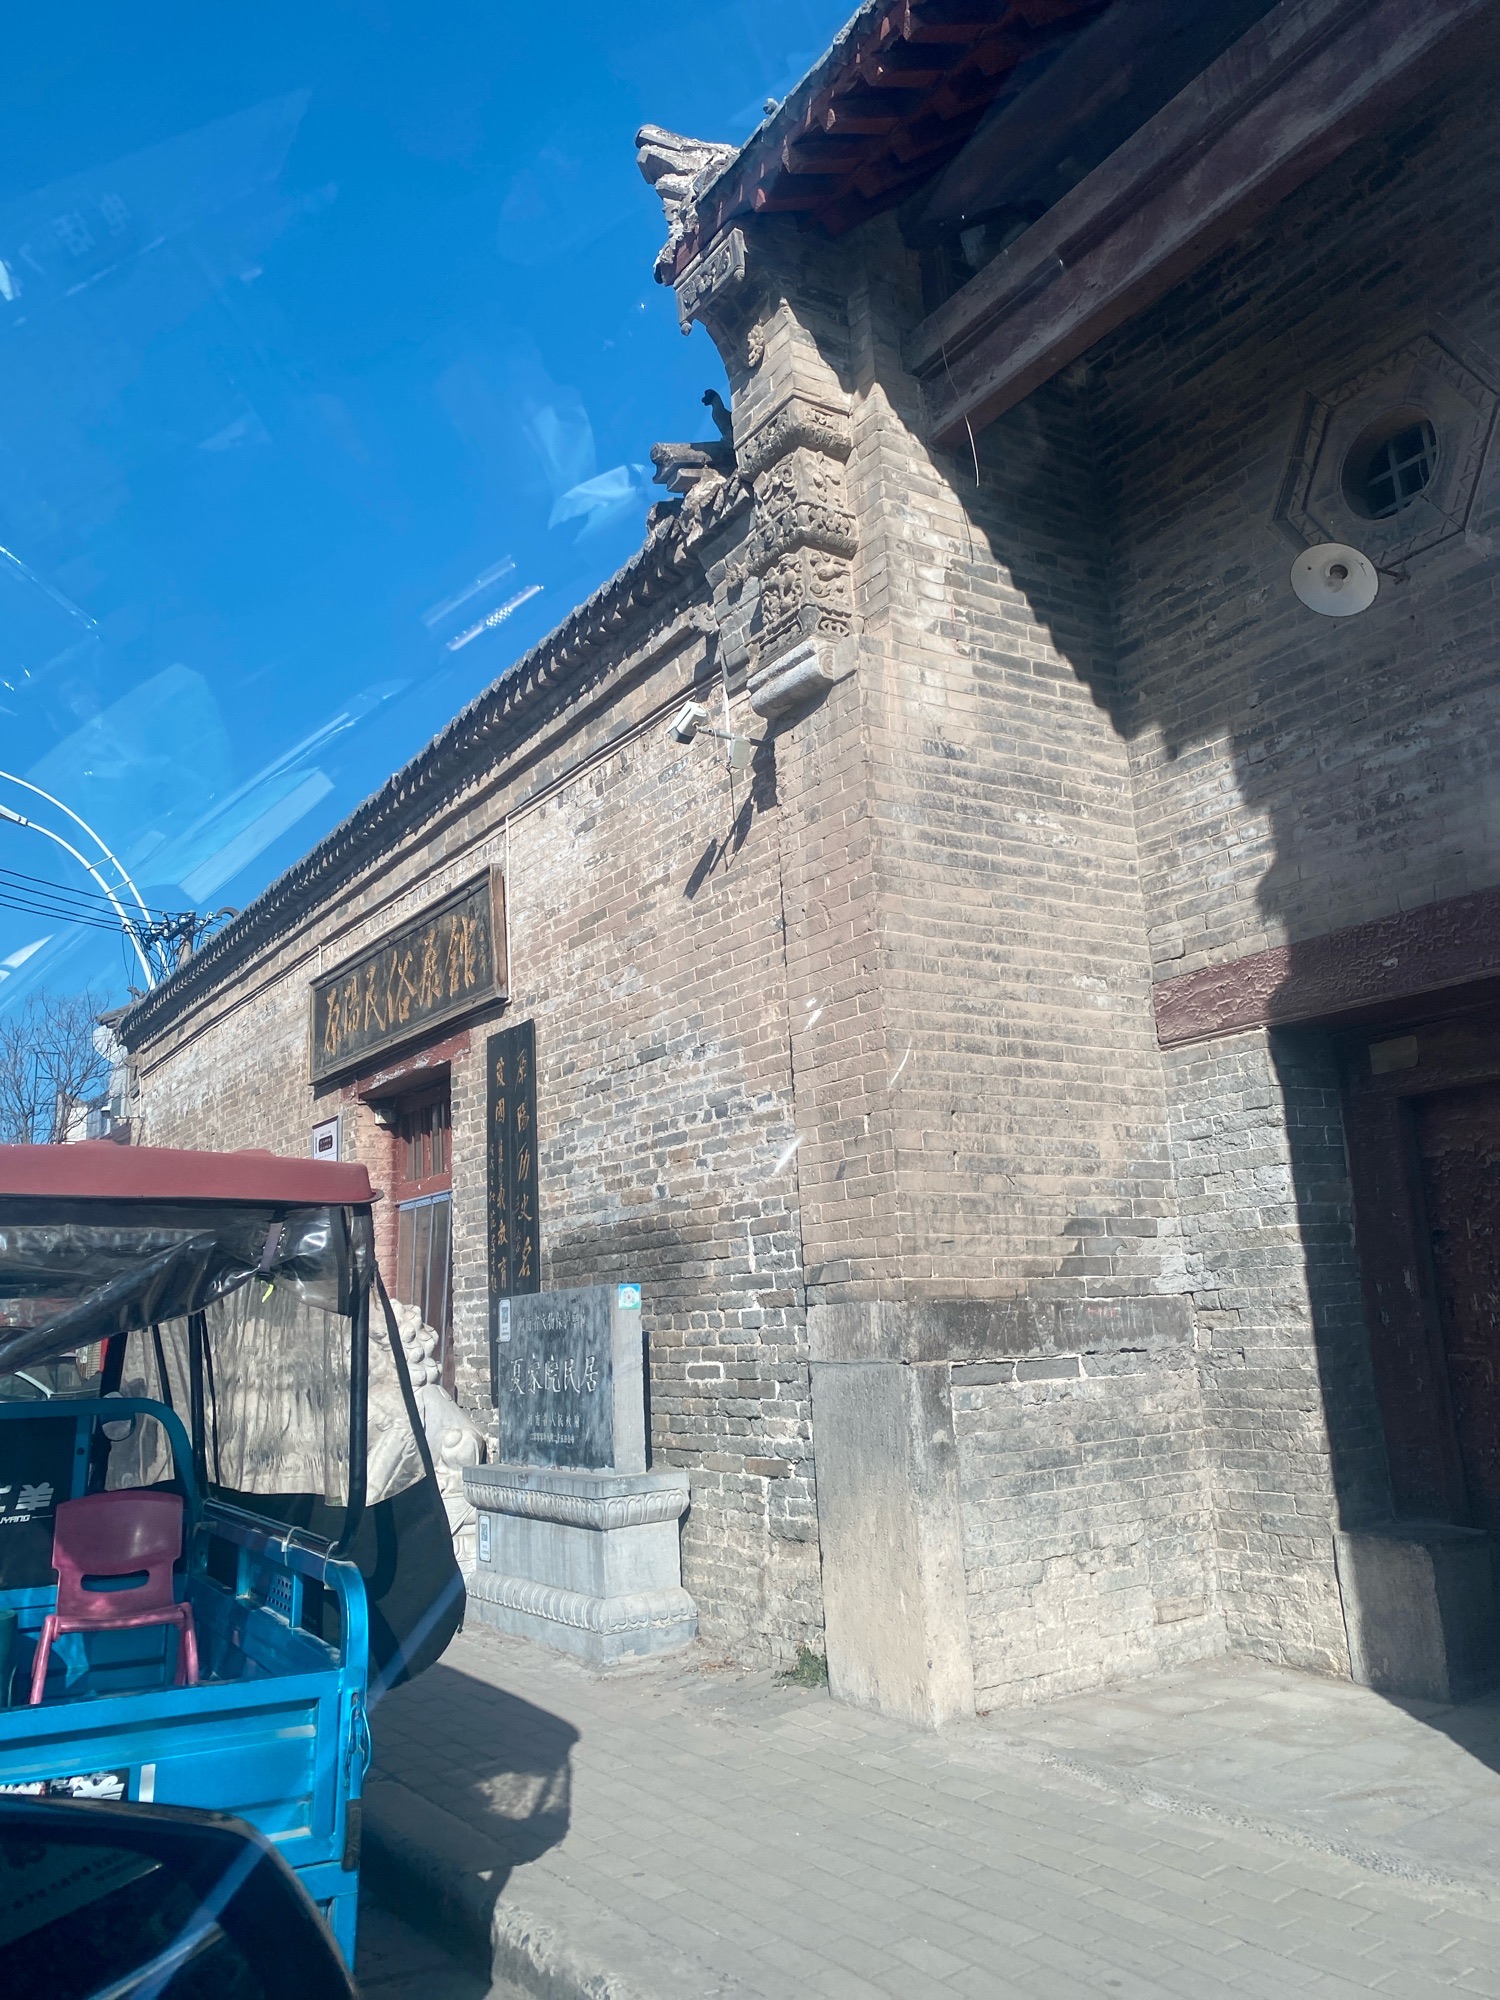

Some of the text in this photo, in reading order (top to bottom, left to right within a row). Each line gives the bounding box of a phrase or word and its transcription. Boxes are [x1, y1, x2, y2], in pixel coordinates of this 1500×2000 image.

[510, 1353, 598, 1395] 夏家院民居
[527, 1412, 580, 1429] 河南省人民政府
